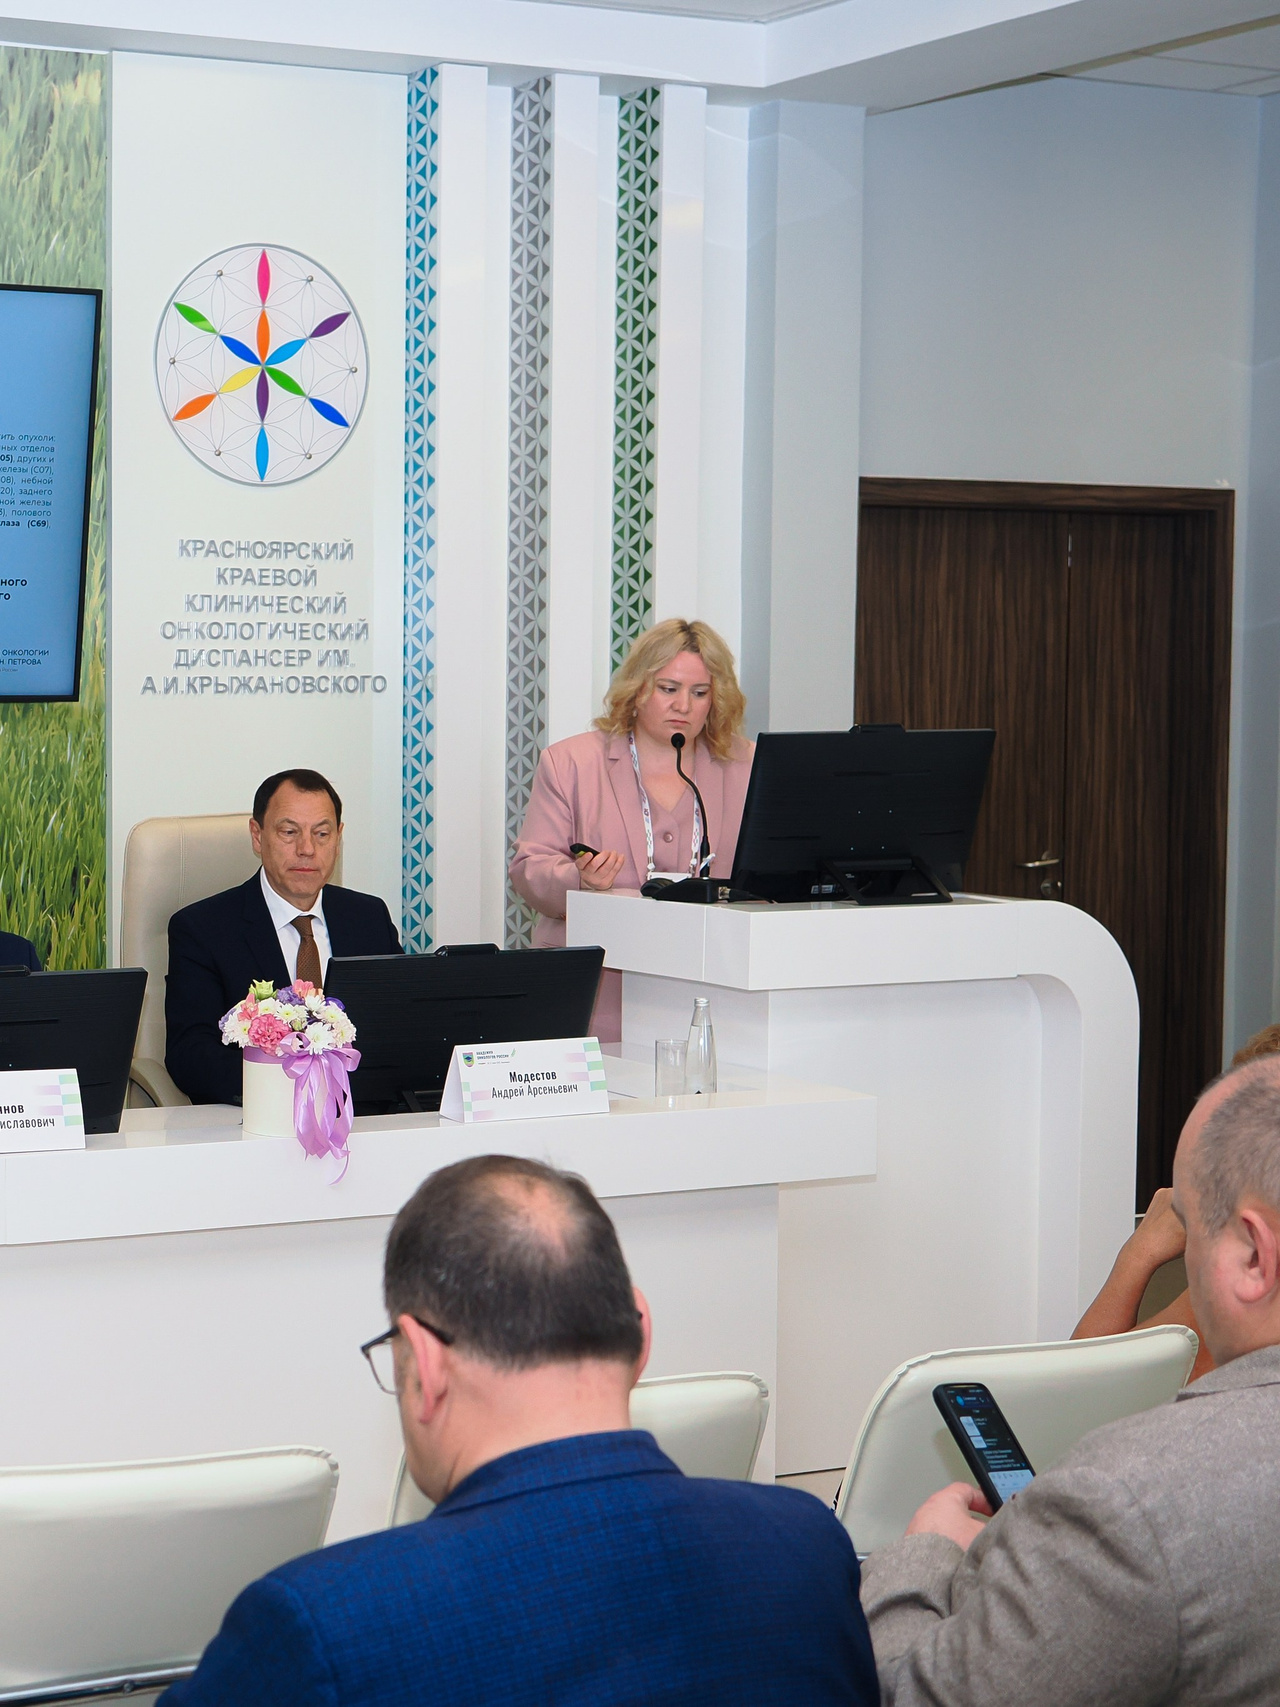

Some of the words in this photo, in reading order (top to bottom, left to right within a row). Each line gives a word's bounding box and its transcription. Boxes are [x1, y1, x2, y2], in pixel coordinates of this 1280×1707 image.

[18, 434, 55, 443] опухоли:
[20, 445, 55, 454] отделов
[17, 455, 46, 464] других
[21, 475, 53, 484] небной
[19, 488, 53, 497] заднего
[178, 539, 354, 560] КРАСНОЯРСКИЙ
[216, 565, 317, 587] КРАЕВОЙ
[185, 592, 347, 614] КЛИНИЧЕСКИЙ
[160, 618, 369, 640] ОНКОЛОГИЧЕСКИЙ
[173, 649, 312, 670] ДИСПАНСЕР
[510, 1071, 557, 1084] Модестов
[492, 1086, 525, 1099] Андрей
[527, 1084, 578, 1096] Арсеньевич
